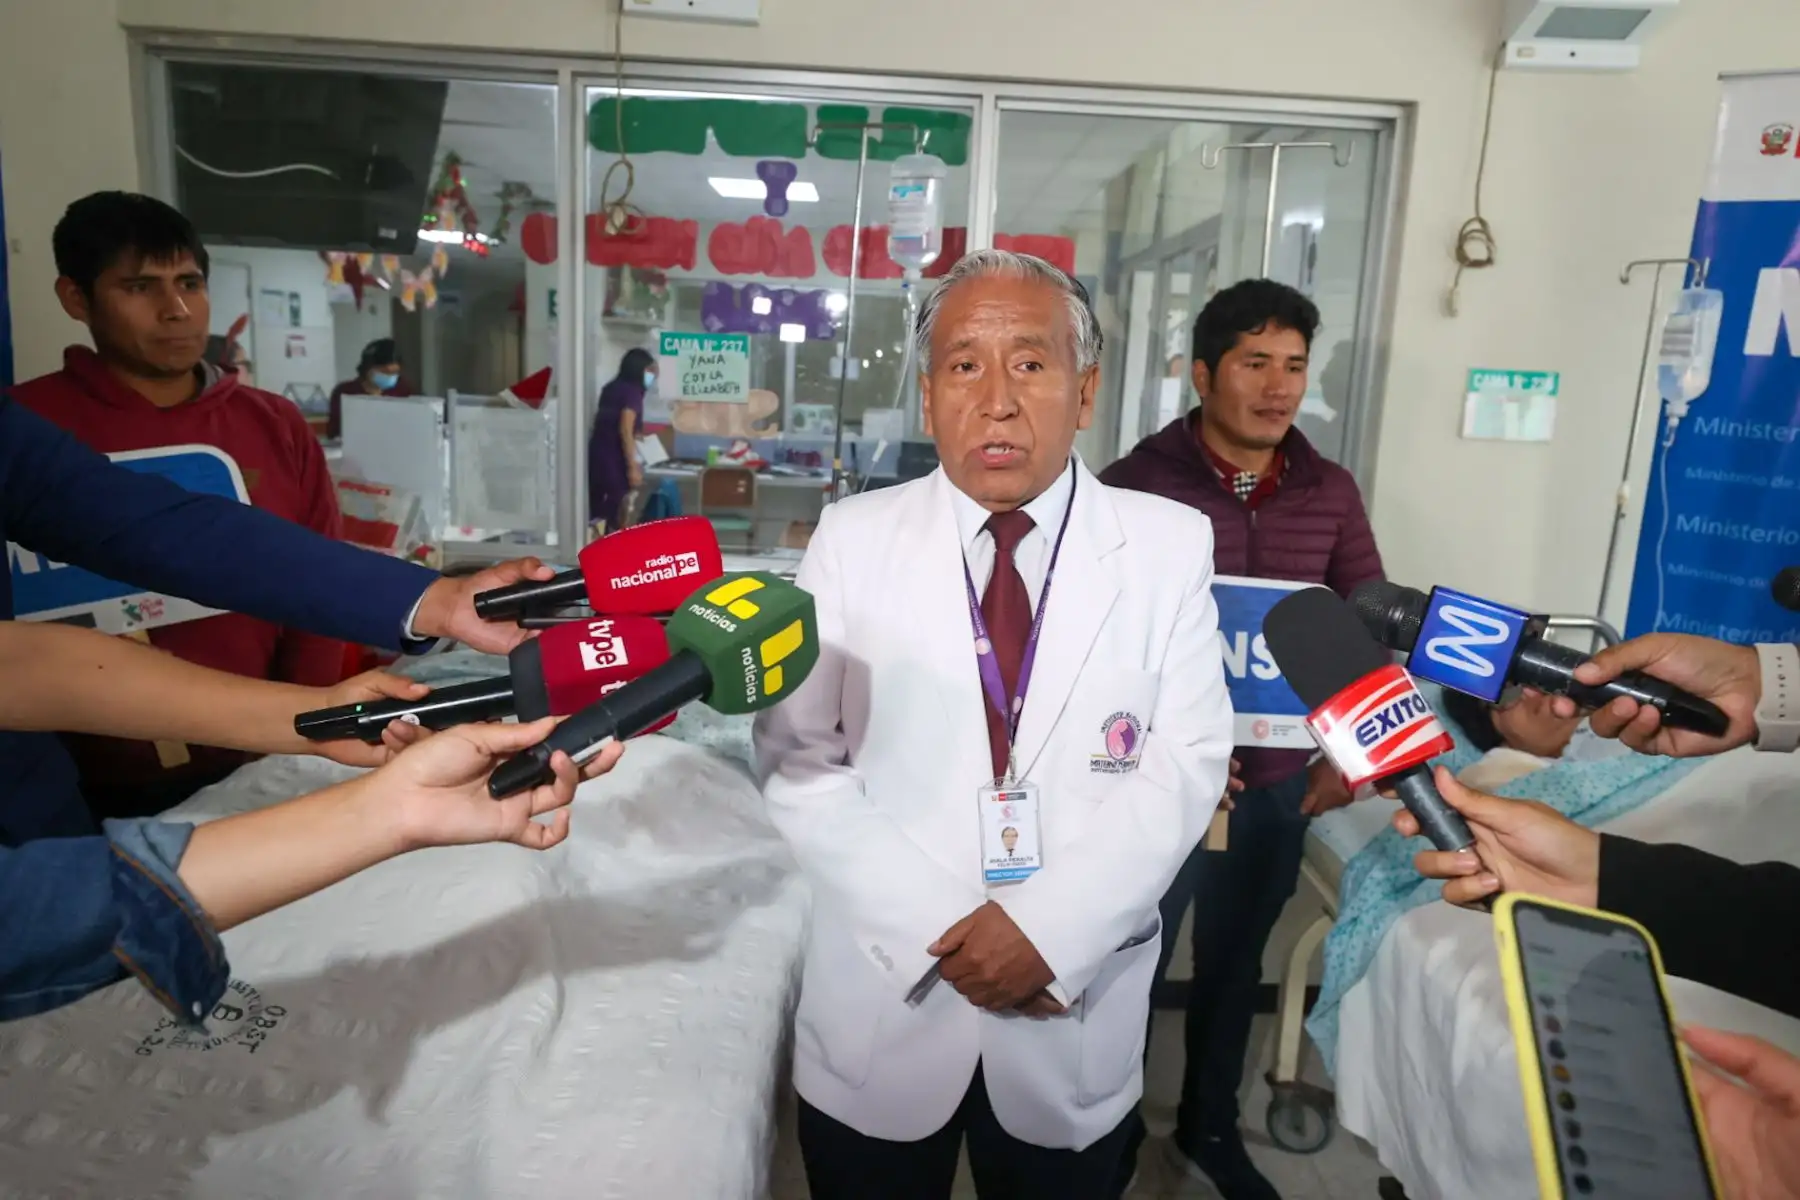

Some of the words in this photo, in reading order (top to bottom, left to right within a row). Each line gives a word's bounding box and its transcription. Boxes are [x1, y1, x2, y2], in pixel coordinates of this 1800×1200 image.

[664, 337, 699, 351] CAMA
[721, 340, 743, 352] 237
[689, 354, 726, 369] YANA
[1676, 513, 1800, 545] Ministerio
[645, 552, 674, 569] radio
[688, 603, 738, 633] noticias
[741, 647, 759, 704] noticias
[1355, 693, 1427, 748] EXITO
[238, 1005, 287, 1053] OBST
